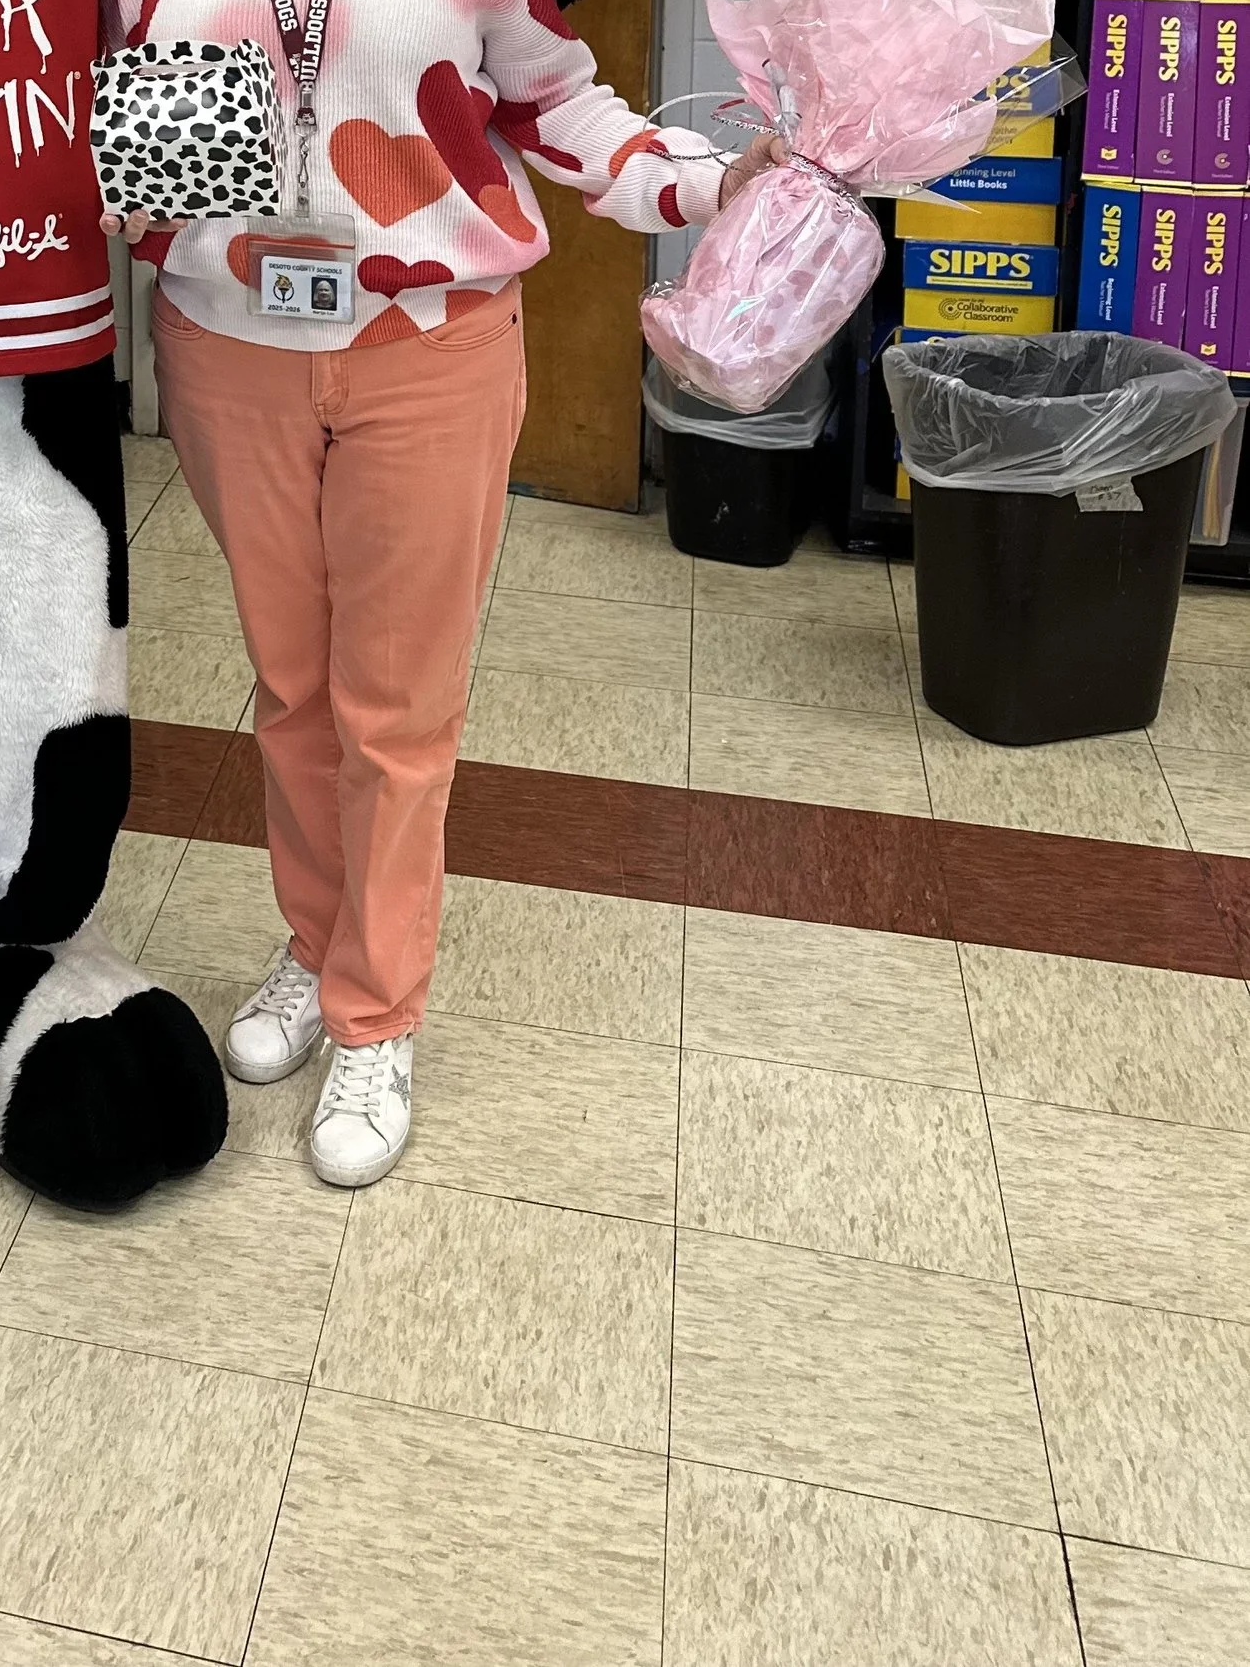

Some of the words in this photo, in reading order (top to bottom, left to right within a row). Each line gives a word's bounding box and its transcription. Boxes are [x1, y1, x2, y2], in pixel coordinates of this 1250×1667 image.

[1105, 13, 1128, 78] SIPPS
[1158, 16, 1181, 81] SIPPS
[1216, 19, 1237, 85] SIPPS
[986, 74, 1031, 99] PS
[1112, 89, 1120, 117] Extension
[1167, 93, 1175, 121] Extension
[1224, 96, 1232, 124] Extension
[1110, 118, 1118, 133] Level
[950, 178, 976, 188] Little
[977, 179, 1007, 189] Books
[953, 167, 989, 178] ginning
[991, 168, 1016, 177] Level
[1100, 204, 1122, 267] SIPPS
[1152, 208, 1176, 272] SIPPS
[1204, 212, 1226, 275] SIPPS
[268, 263, 291, 271] DESOTO
[292, 264, 316, 272] COUNTY
[317, 267, 343, 275] SCHOOLS
[929, 248, 1031, 278] SIPPS
[1106, 277, 1115, 305] Beginning
[1158, 283, 1167, 310] Extension
[1211, 286, 1219, 313] Extension
[267, 304, 301, 313] 2025-2026
[957, 301, 1019, 314] Collaborative
[963, 311, 1014, 322] Classroom
[1105, 306, 1113, 321] Level
